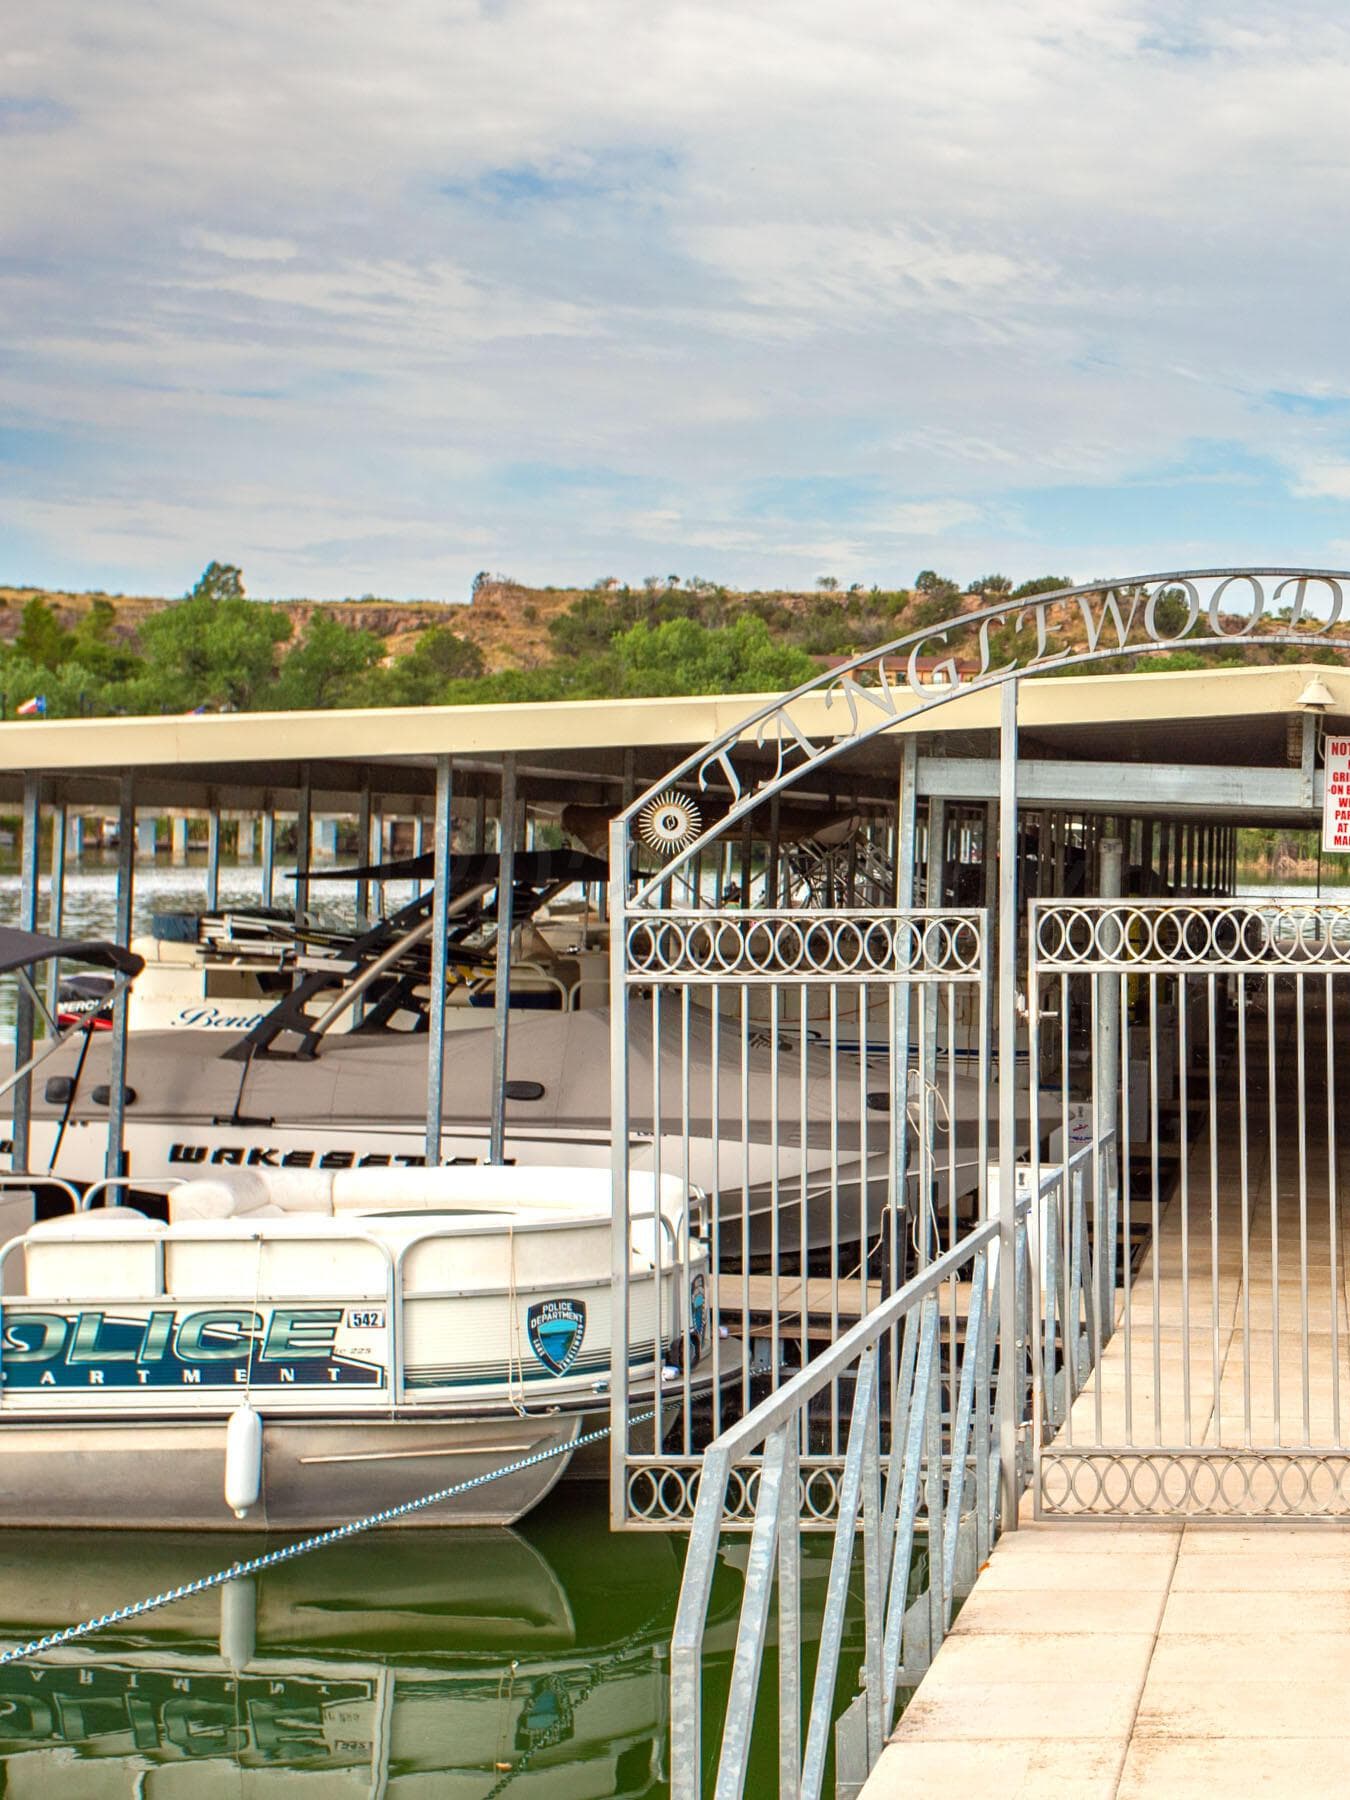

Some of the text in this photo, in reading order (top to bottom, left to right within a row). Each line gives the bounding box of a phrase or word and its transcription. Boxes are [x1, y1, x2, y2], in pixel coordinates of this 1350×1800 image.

[697, 575, 1344, 811] TANGLEWOOD
[1330, 784, 1344, 795] ON
[1337, 822, 1349, 833] AT
[542, 1302, 573, 1314] POLICE
[353, 1312, 378, 1327] 542
[530, 1311, 583, 1329] DEPARTMENT
[0, 1367, 340, 1385] ARTMENT
